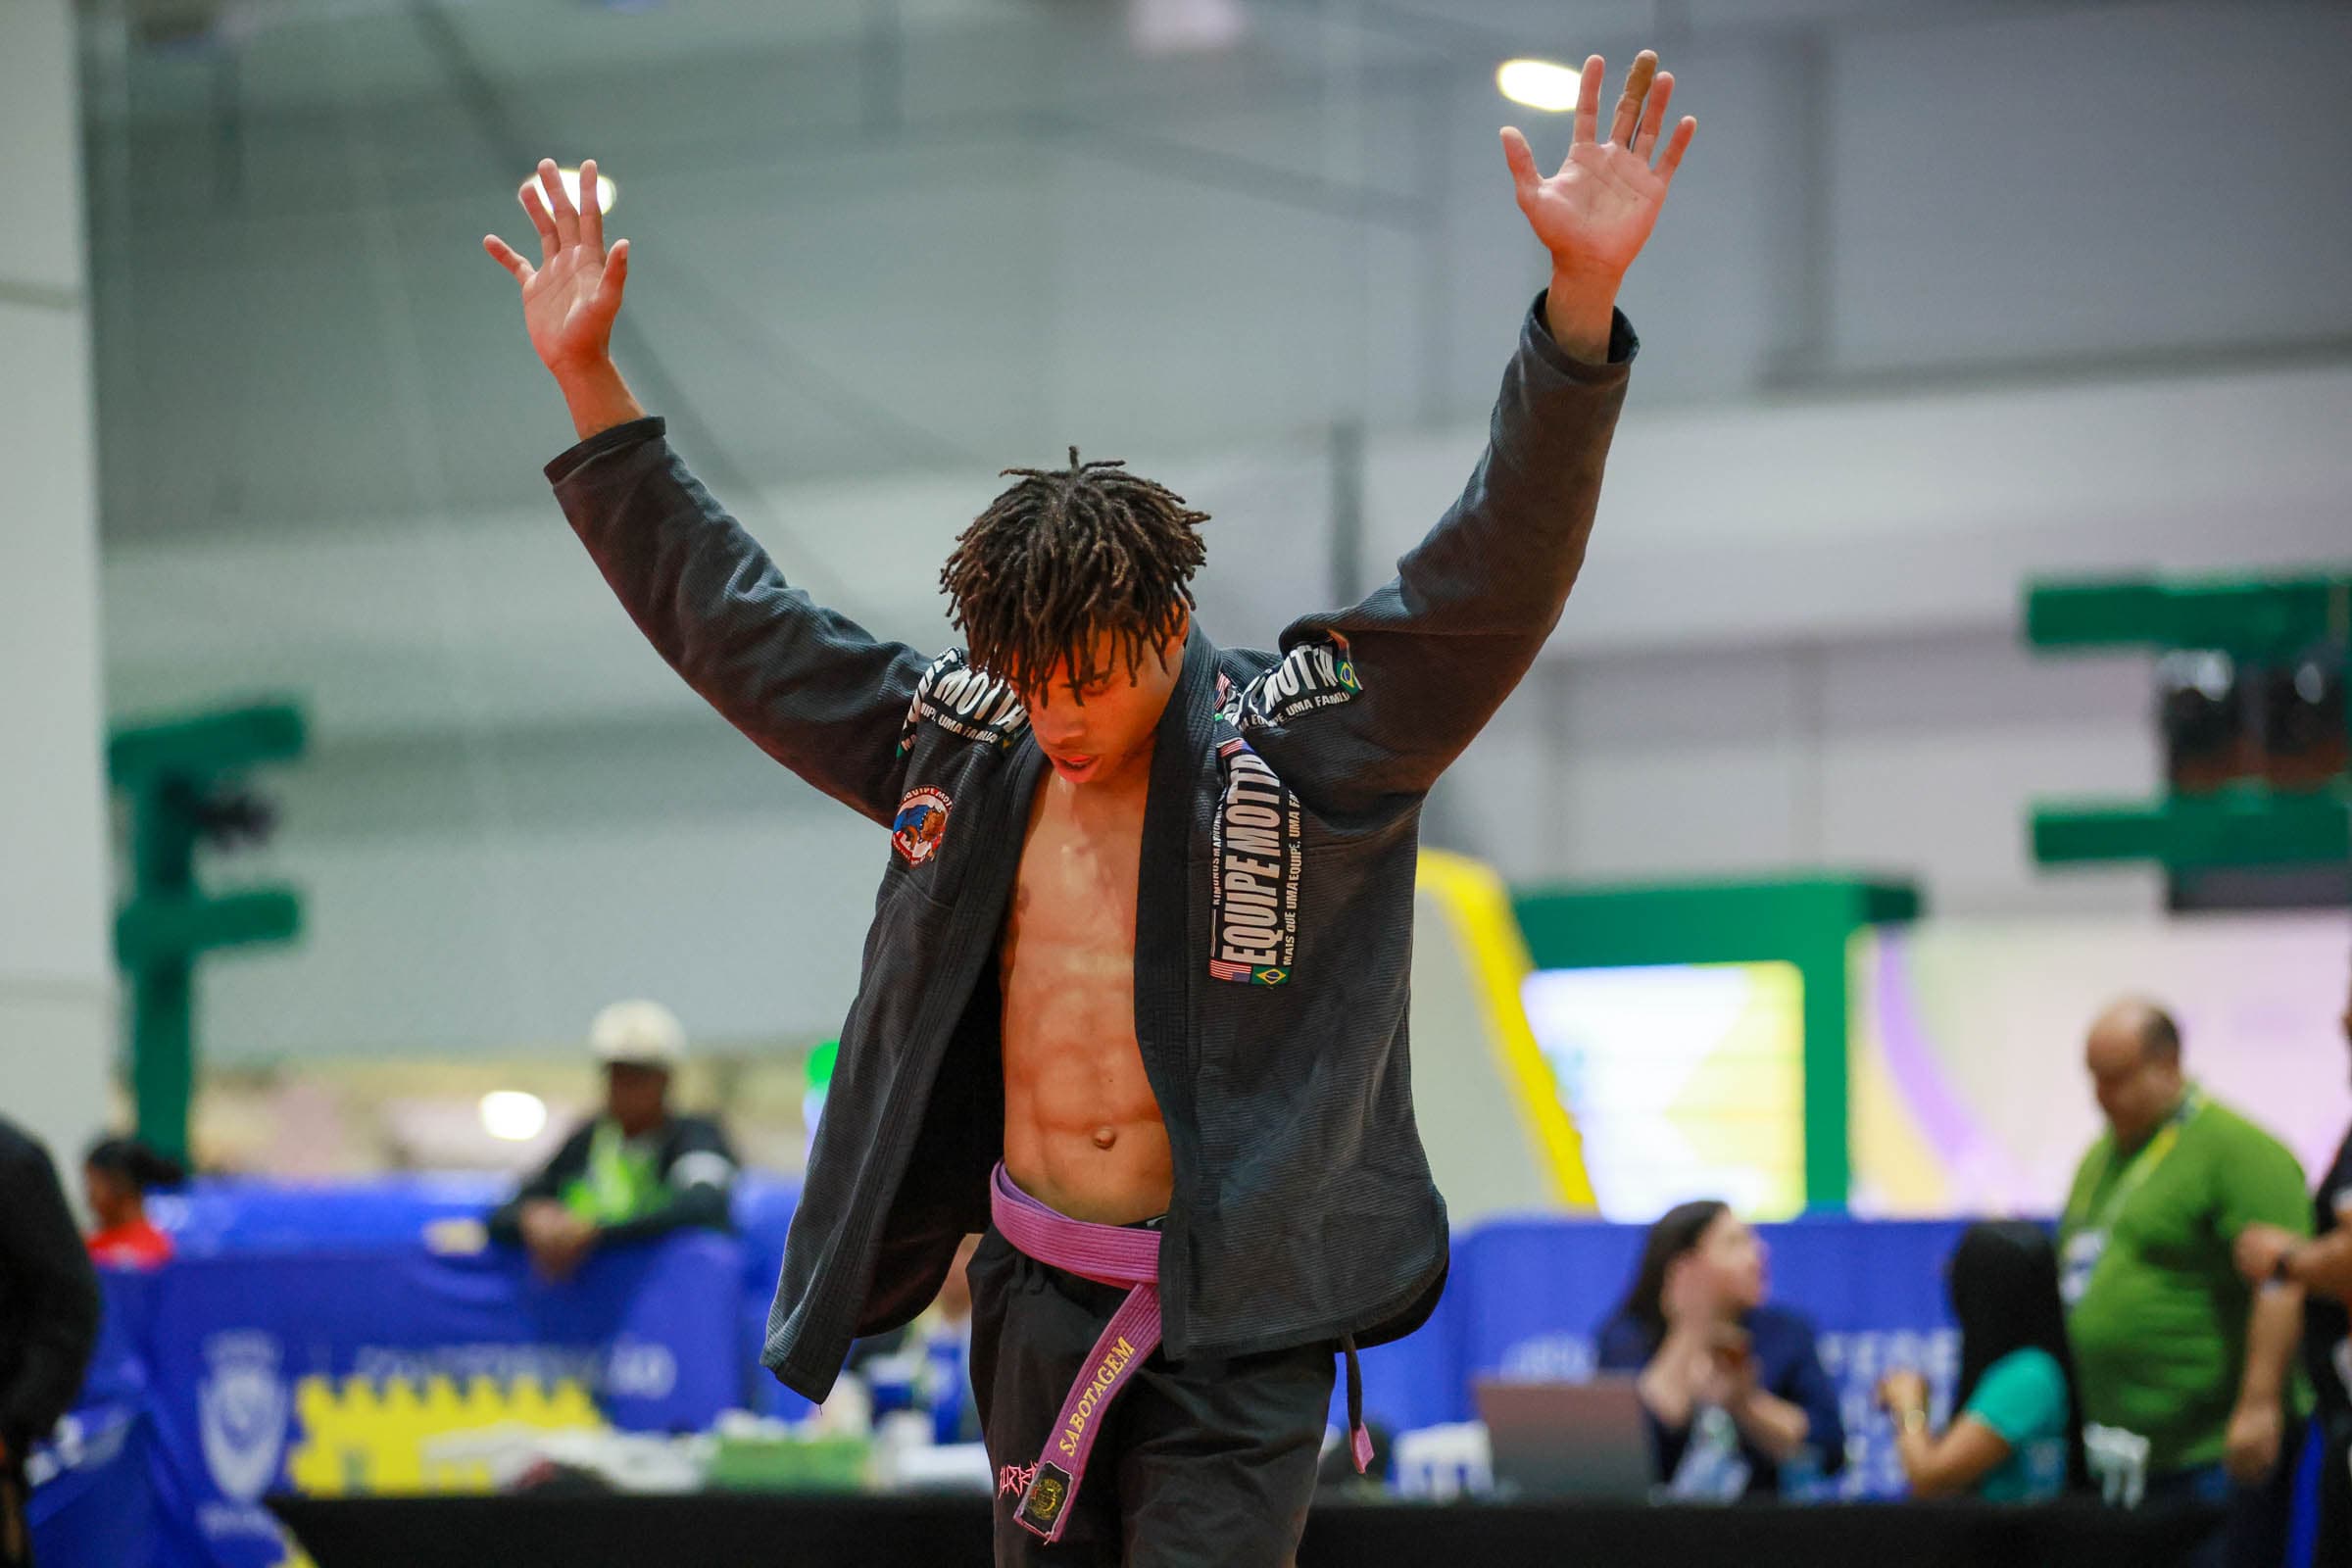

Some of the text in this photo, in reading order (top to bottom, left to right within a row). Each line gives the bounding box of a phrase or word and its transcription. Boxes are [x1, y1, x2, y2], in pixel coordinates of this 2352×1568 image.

[1285, 698, 1314, 716] UMA
[938, 713, 964, 735] UMA
[1288, 810, 1301, 838] UMA
[1286, 881, 1299, 909] UMA
[1221, 855, 1284, 965] EQUIPE
[1285, 911, 1298, 934] QUE
[1283, 935, 1296, 966] MAIS
[1058, 1336, 1135, 1457] SABOTAGEM
